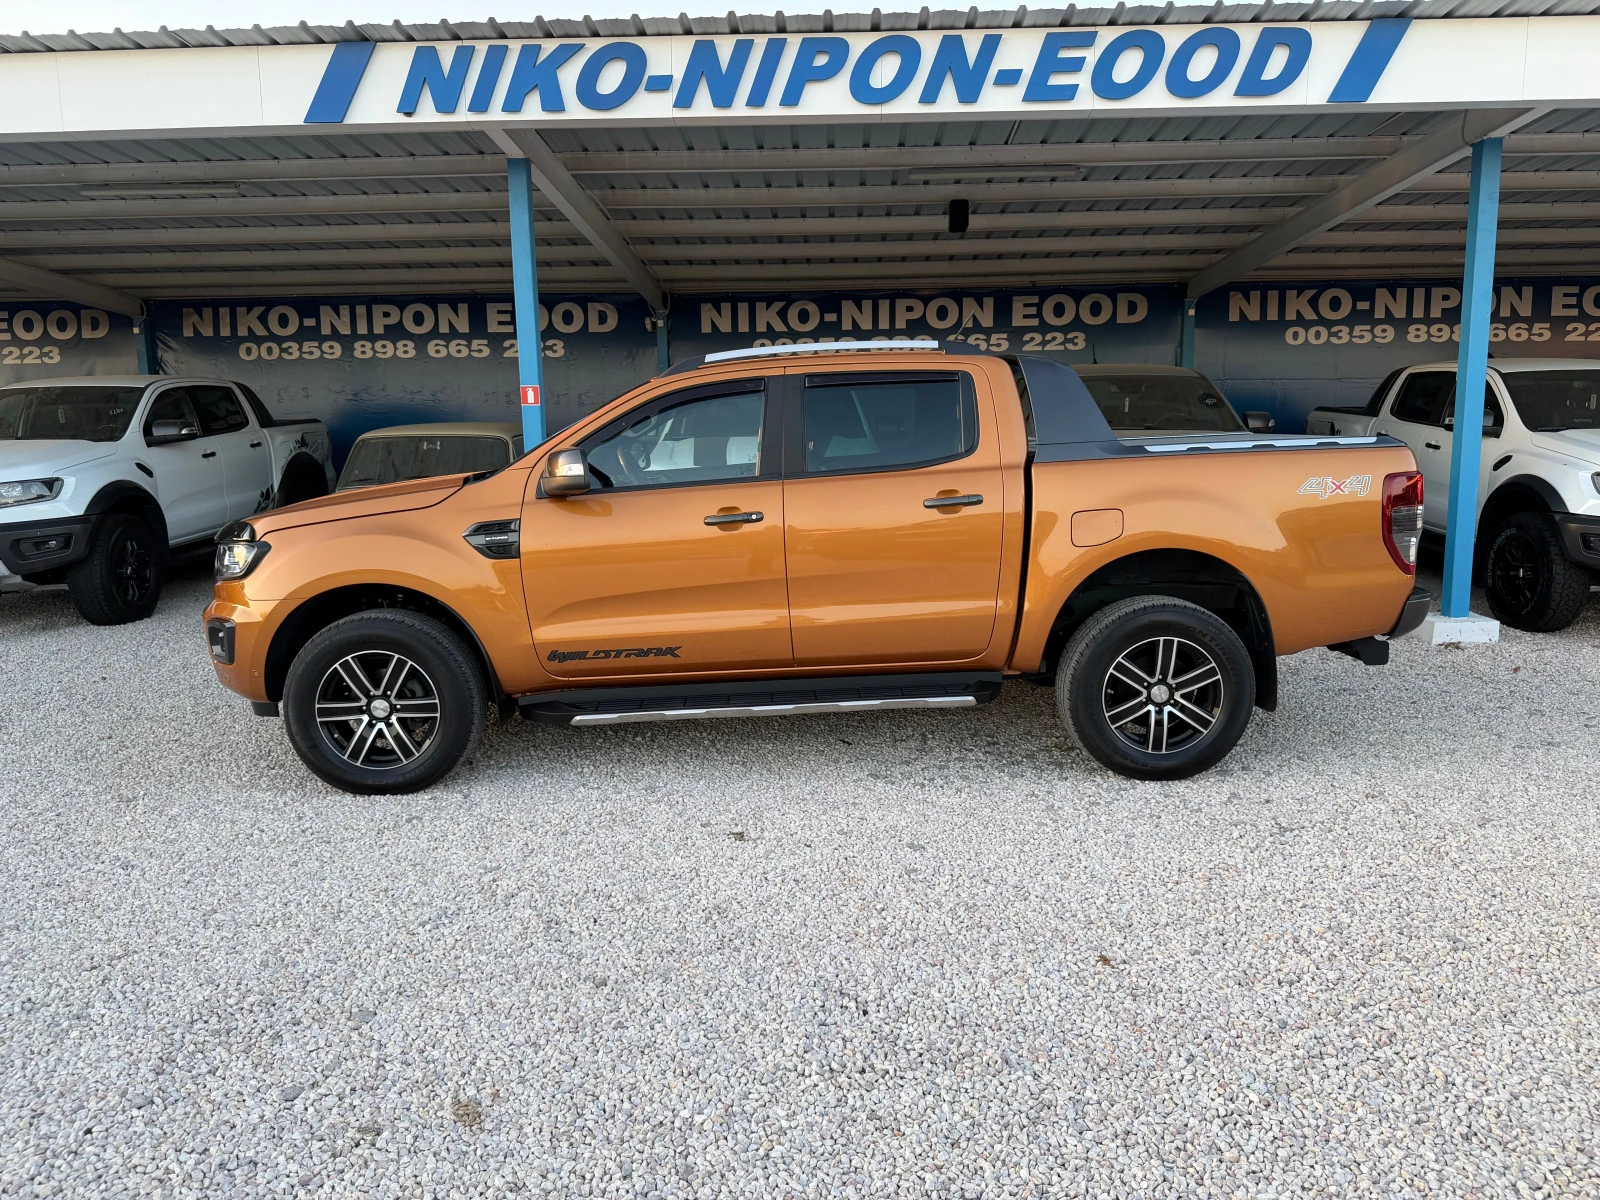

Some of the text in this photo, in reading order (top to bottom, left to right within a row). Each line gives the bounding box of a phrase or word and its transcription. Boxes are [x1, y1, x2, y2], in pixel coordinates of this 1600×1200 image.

[397, 26, 1312, 113] NIKO-NIPON-EOOD
[701, 293, 1149, 334] NIKO-NIPON EOOD
[1228, 286, 1533, 322] NIKO-NIPN
[182, 302, 470, 337] NIKO-NIPON
[1022, 331, 1086, 351] 223
[1285, 325, 1395, 346] 00359
[1489, 322, 1552, 342] 665
[2, 346, 61, 364] 223
[239, 339, 565, 361] 00359 898 665 23
[547, 645, 684, 663] WILDTRAK
